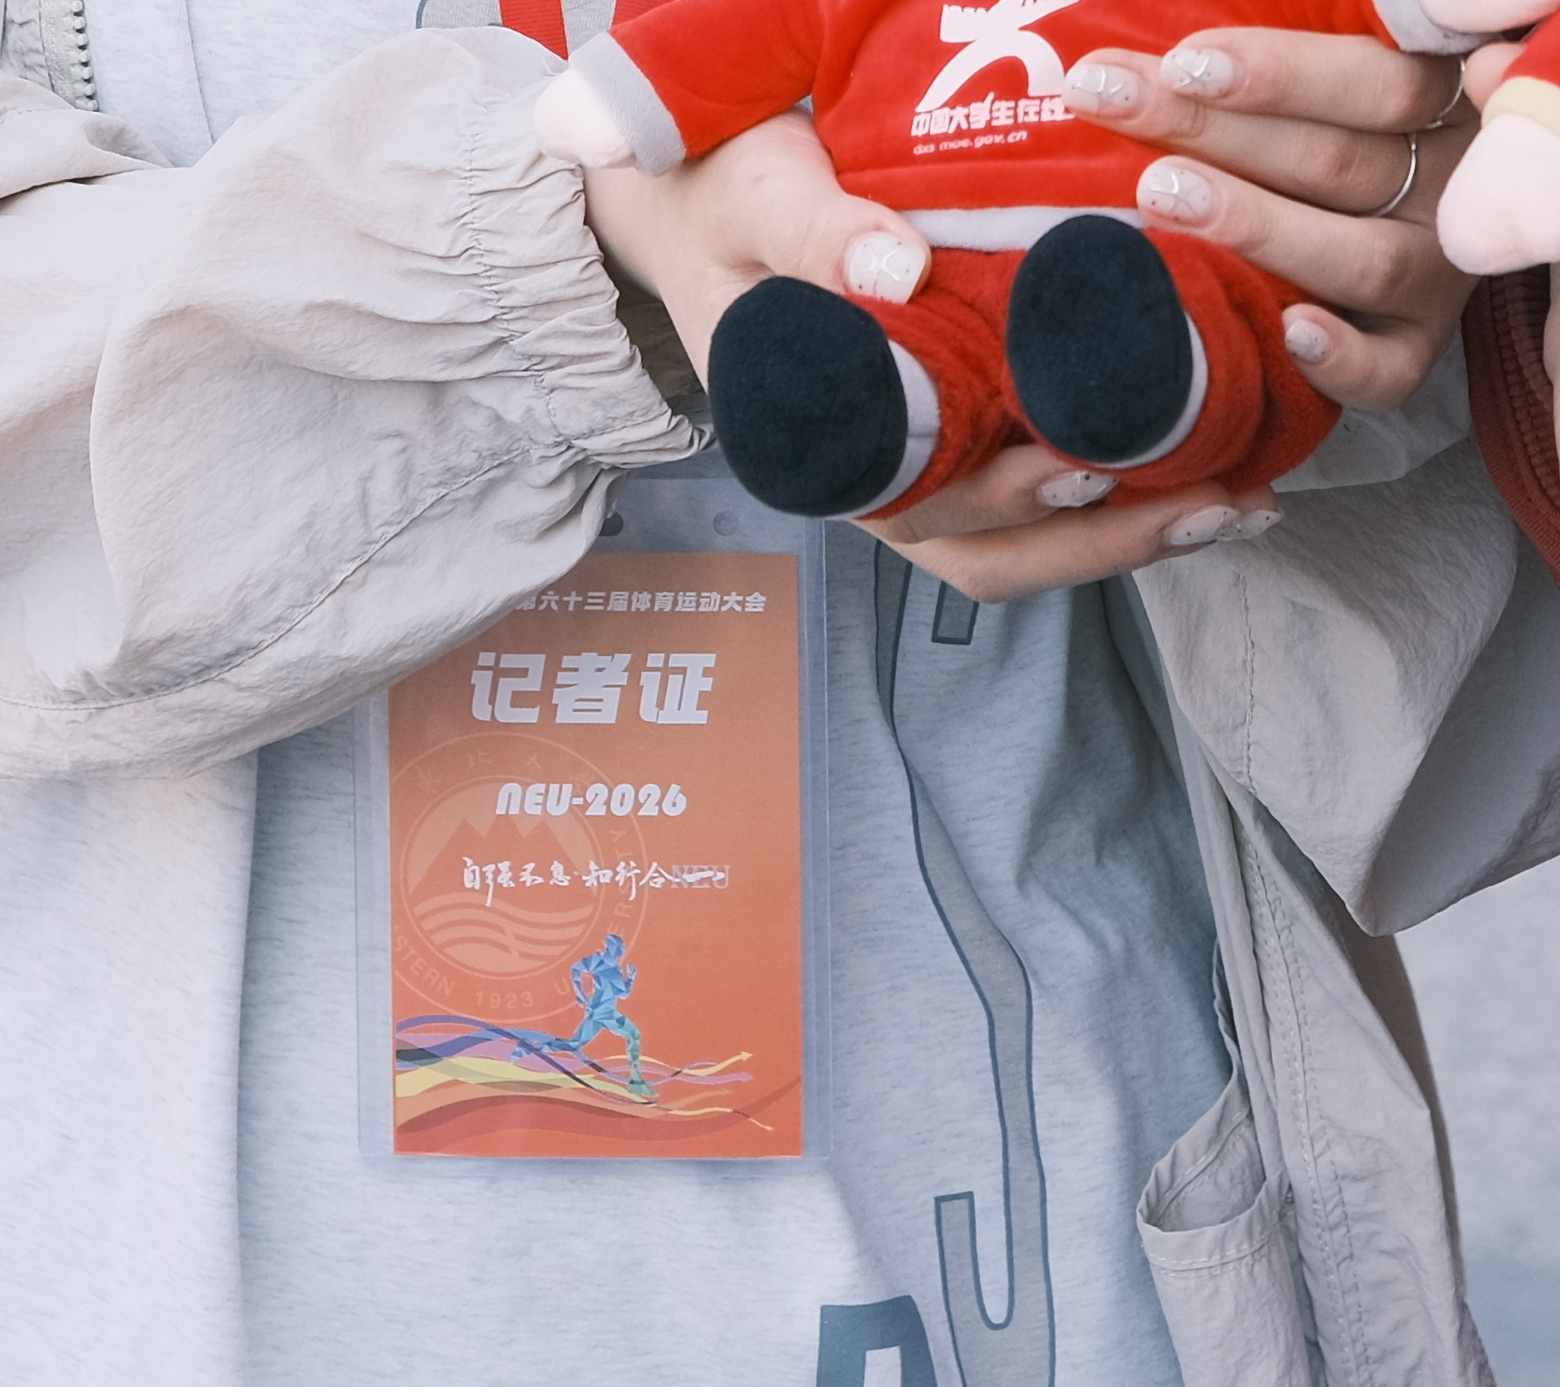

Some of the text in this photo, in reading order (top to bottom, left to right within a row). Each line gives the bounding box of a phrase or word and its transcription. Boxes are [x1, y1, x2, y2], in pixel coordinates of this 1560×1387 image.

[470, 652, 717, 725] 记者证
[495, 782, 688, 817] NEU-2026
[394, 925, 455, 996] STERN
[475, 990, 535, 1010] 1923
